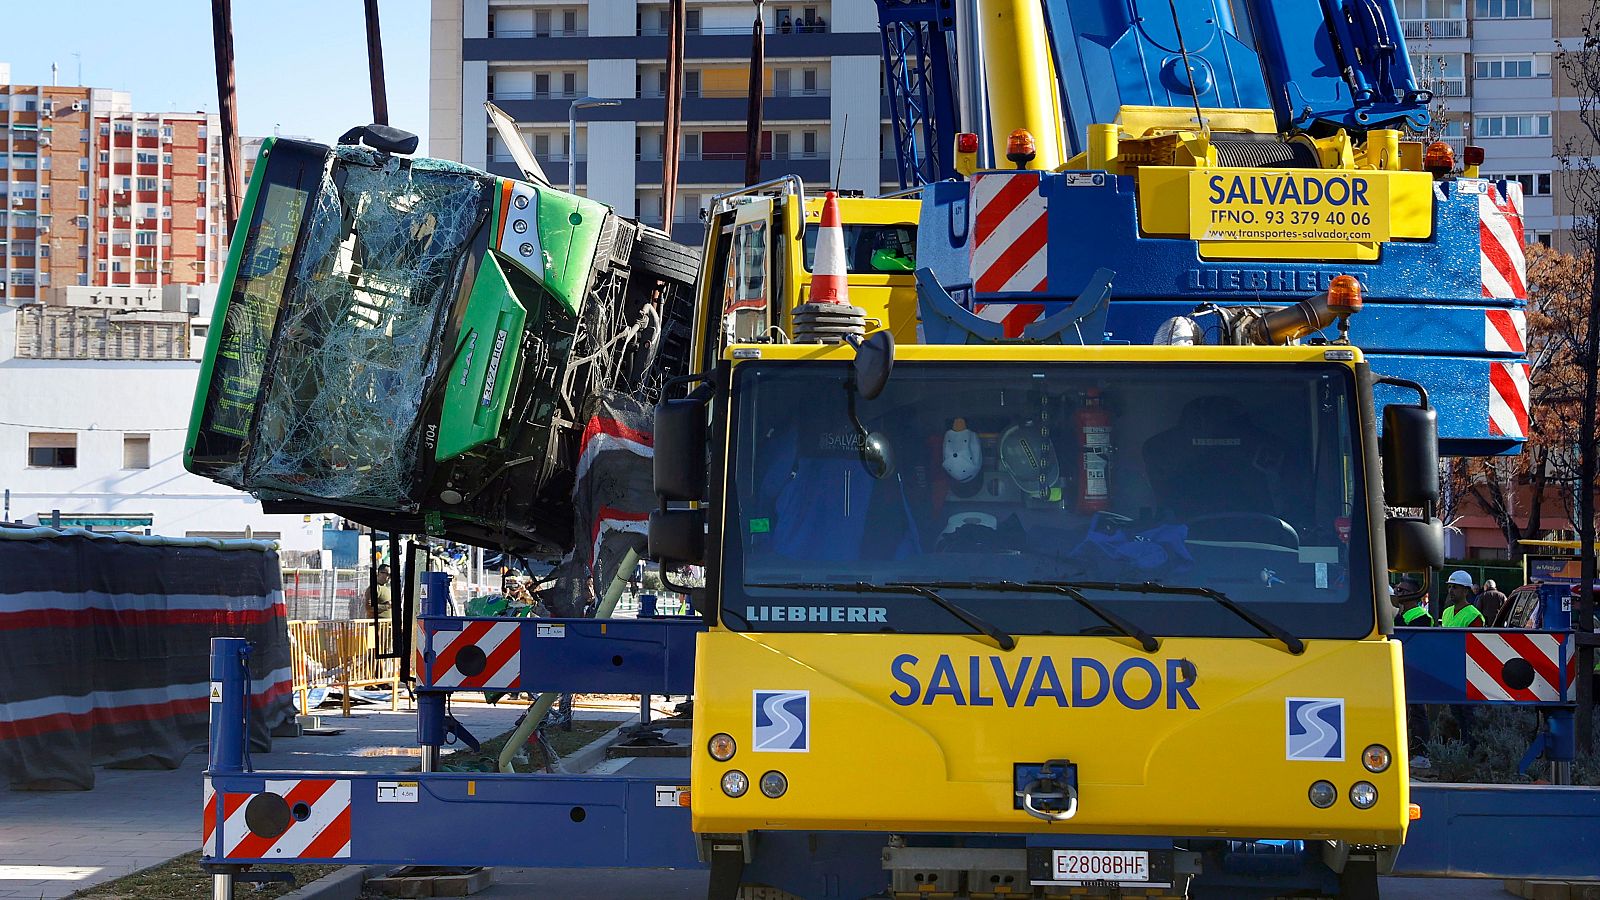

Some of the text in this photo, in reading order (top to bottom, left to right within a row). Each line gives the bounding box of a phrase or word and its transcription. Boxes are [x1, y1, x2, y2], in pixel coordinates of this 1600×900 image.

[1208, 175, 1370, 206] SALVADOR
[1265, 211, 1285, 224] 93
[1290, 211, 1320, 225] 379
[1325, 212, 1346, 225] 40
[1351, 212, 1371, 225] 06
[1208, 229, 1371, 240] www.transportes-salvador.com
[460, 331, 478, 387] MAN
[493, 334, 506, 361] HCK
[424, 424, 437, 449] 3104
[746, 606, 888, 623] LIEBHERR
[889, 653, 1201, 710] SALVADOR
[1057, 855, 1145, 874] E2808BHF
